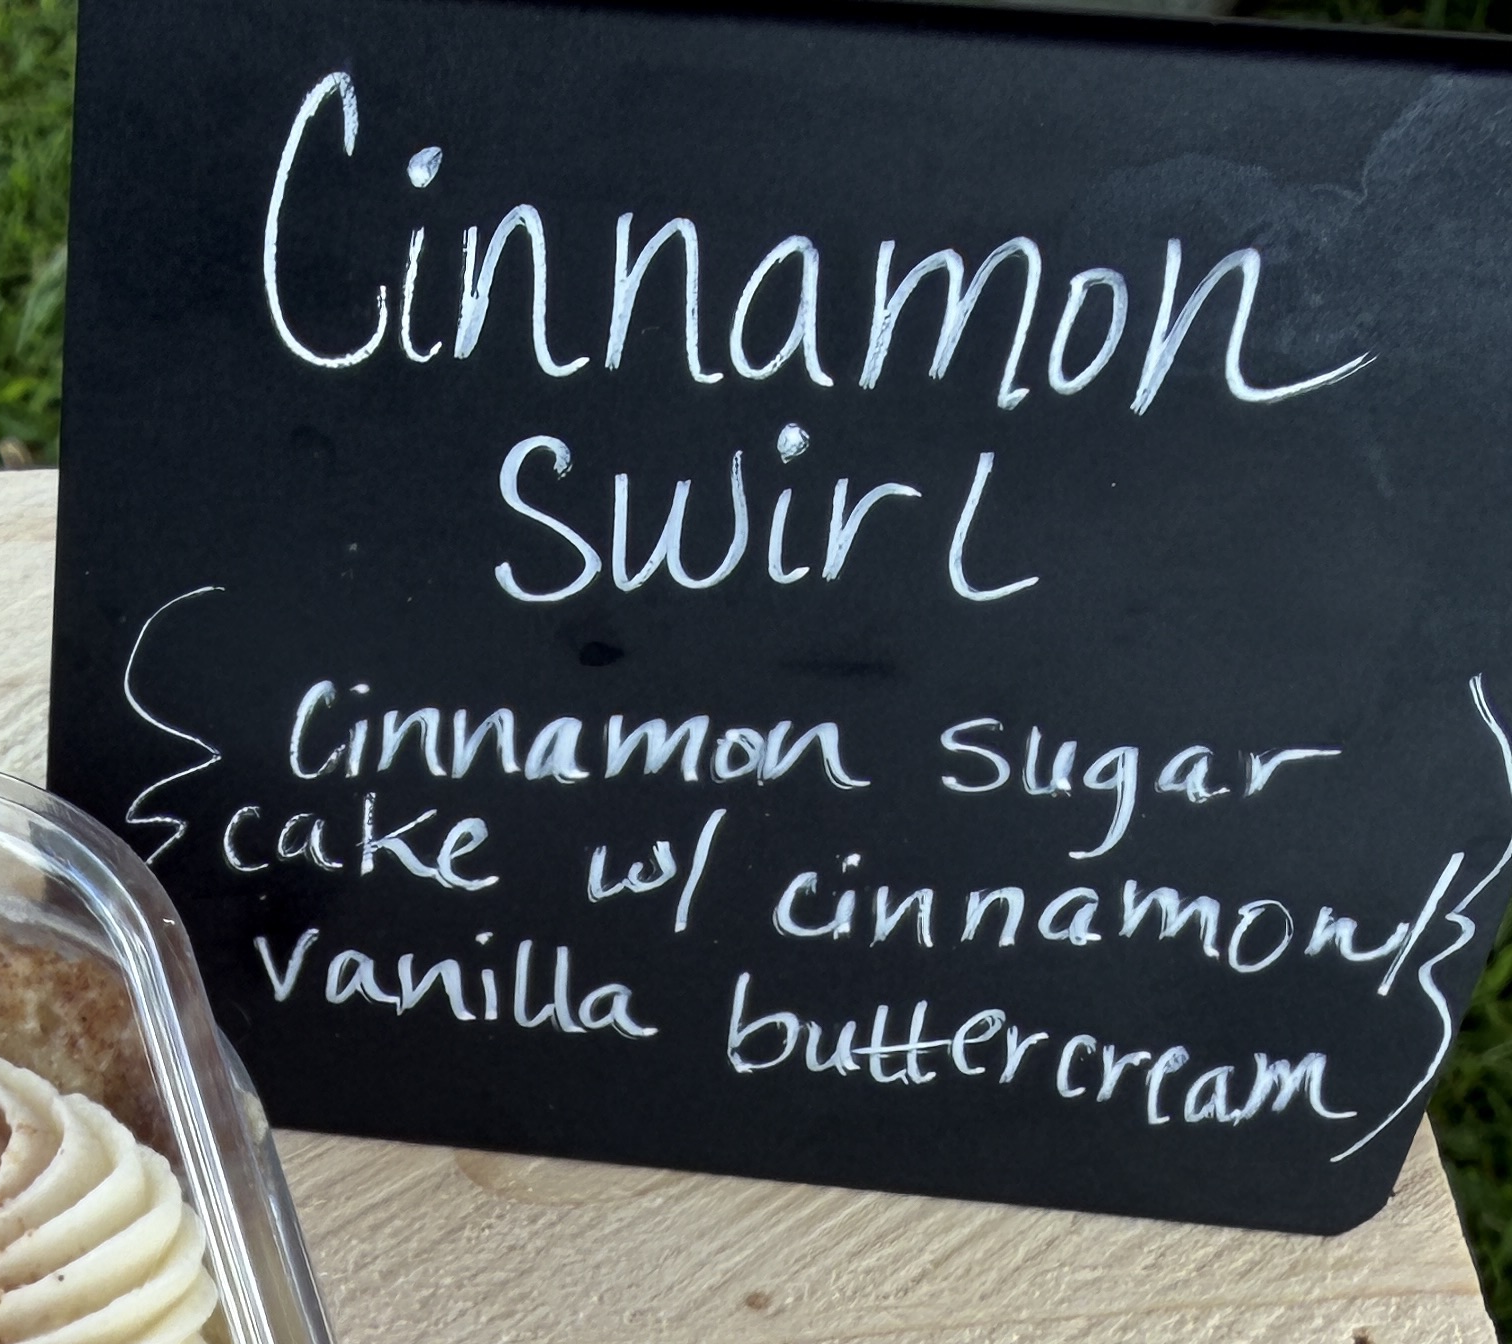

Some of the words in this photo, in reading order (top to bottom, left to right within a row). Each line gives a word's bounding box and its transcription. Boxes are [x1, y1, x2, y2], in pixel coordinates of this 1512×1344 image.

[263, 70, 1378, 418] Cinnamon
[223, 791, 500, 892] cake
[587, 808, 727, 933] w/
[940, 717, 1343, 860] sugar
[254, 927, 658, 1038] vanilla
[727, 971, 1358, 1128] buttercream
